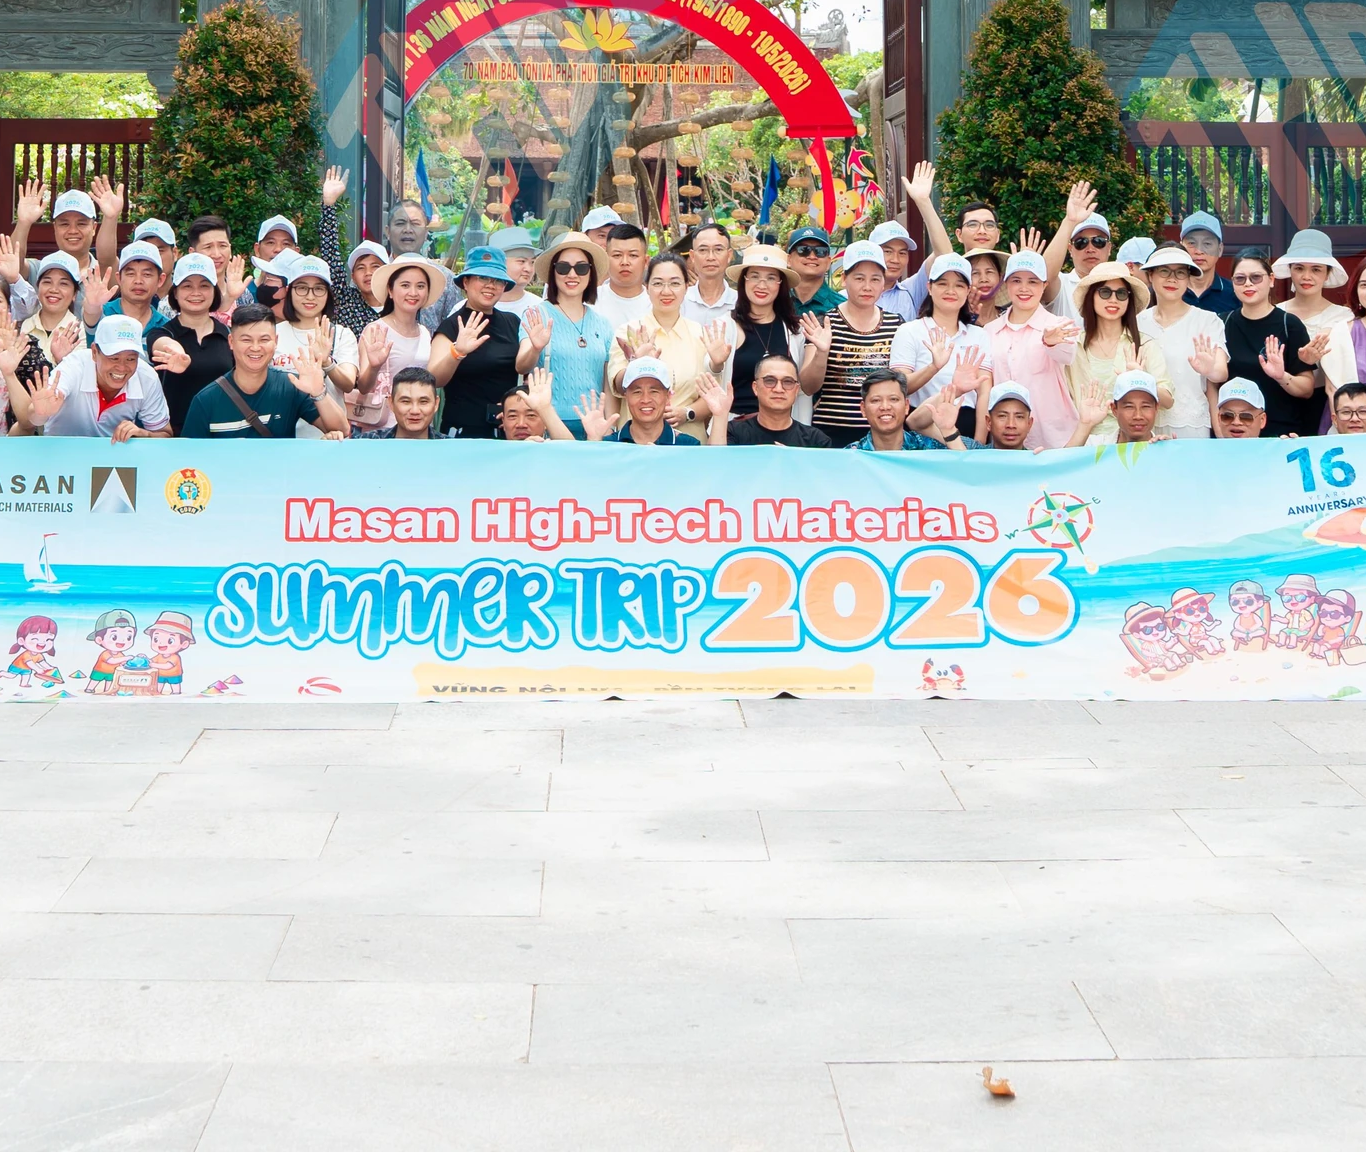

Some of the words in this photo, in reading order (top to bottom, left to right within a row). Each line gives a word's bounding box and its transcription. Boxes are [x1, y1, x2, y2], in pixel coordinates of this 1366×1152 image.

[410, 29, 434, 59] 136
[424, 10, 462, 41] NĂM
[750, 30, 812, 95] 19/5/2026)
[463, 62, 474, 80] 70
[477, 58, 497, 81] NĂM
[541, 59, 553, 82] VÀ
[555, 59, 578, 82] PHÁT
[581, 63, 598, 82] HUY
[601, 59, 615, 82] GIÁ
[619, 63, 634, 87] TRỊ
[636, 63, 656, 83] KHU
[657, 63, 667, 83] DI
[670, 59, 691, 84] TÍCH
[694, 63, 712, 84] KIM
[714, 60, 734, 84] LIÊN
[1286, 446, 1356, 492] 16
[15, 501, 73, 513] MATERIALS
[285, 498, 458, 543] Masan
[471, 496, 742, 551] High-Tech
[753, 496, 999, 543] Materials
[701, 547, 1078, 652] 2026
